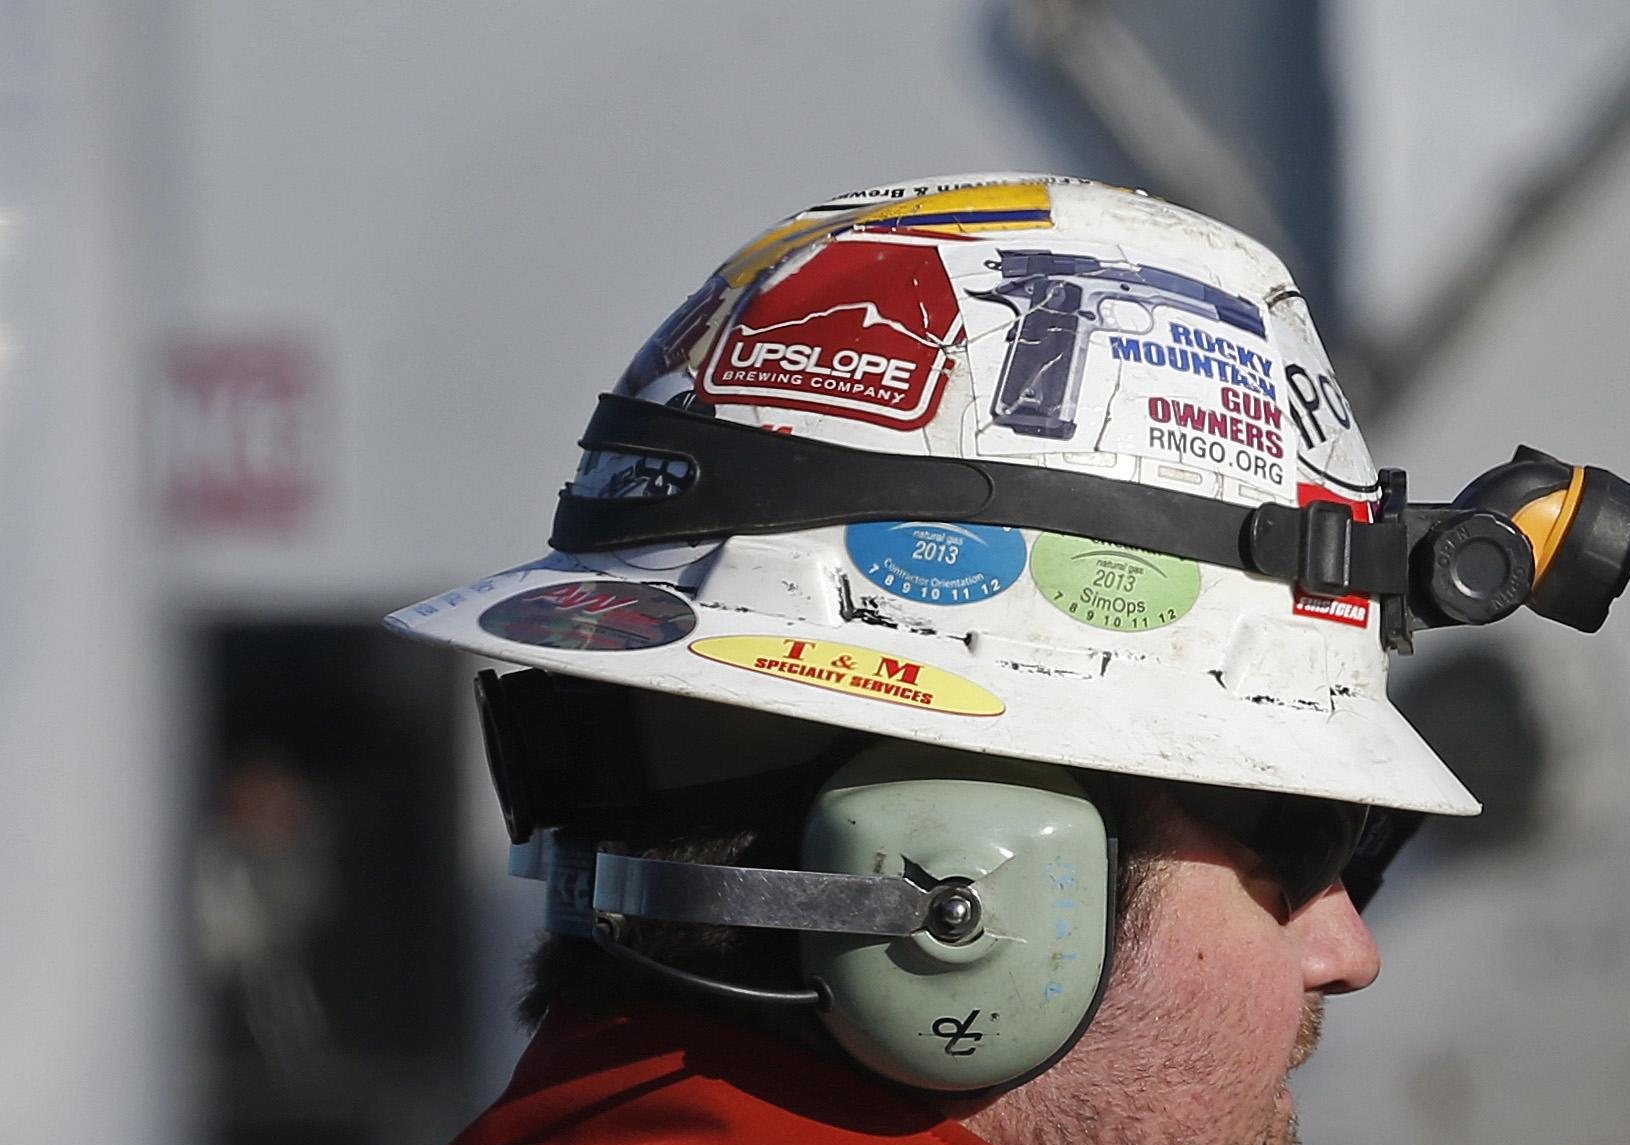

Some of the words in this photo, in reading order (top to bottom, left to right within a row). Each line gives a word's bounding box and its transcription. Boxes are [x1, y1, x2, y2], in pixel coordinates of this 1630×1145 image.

[730, 341, 916, 390] UPSLOPE
[1109, 336, 1276, 401] MOUNTAIN
[1169, 321, 1273, 379] ROCKY
[722, 370, 803, 385] BREWING
[810, 376, 905, 405] COMPANY
[1220, 386, 1282, 430] GUN
[1148, 396, 1284, 460] OWNERS
[1149, 426, 1283, 486] RMGO.ORG
[912, 529, 944, 543] natural
[912, 540, 959, 565] 2013
[868, 562, 880, 574] 7
[884, 574, 895, 587] 8
[901, 582, 912, 594] 9
[921, 587, 940, 601] 10
[951, 587, 970, 601] 11
[981, 578, 1001, 595] 12
[884, 557, 929, 587] Contractor
[930, 572, 984, 589] Orientation
[1093, 569, 1136, 593] 2013
[1096, 559, 1128, 572] natural
[1054, 590, 1064, 601] 7
[1069, 602, 1078, 613] 8
[1086, 610, 1095, 621] 9
[1104, 615, 1121, 628] 10
[1132, 617, 1149, 628] 11
[1158, 608, 1176, 623] 12
[1080, 586, 1146, 618] SimOps
[754, 657, 846, 684] SPECIALTY
[849, 676, 934, 705] SERVICES
[783, 639, 816, 661] T
[830, 654, 859, 671] &
[872, 656, 925, 687] M
